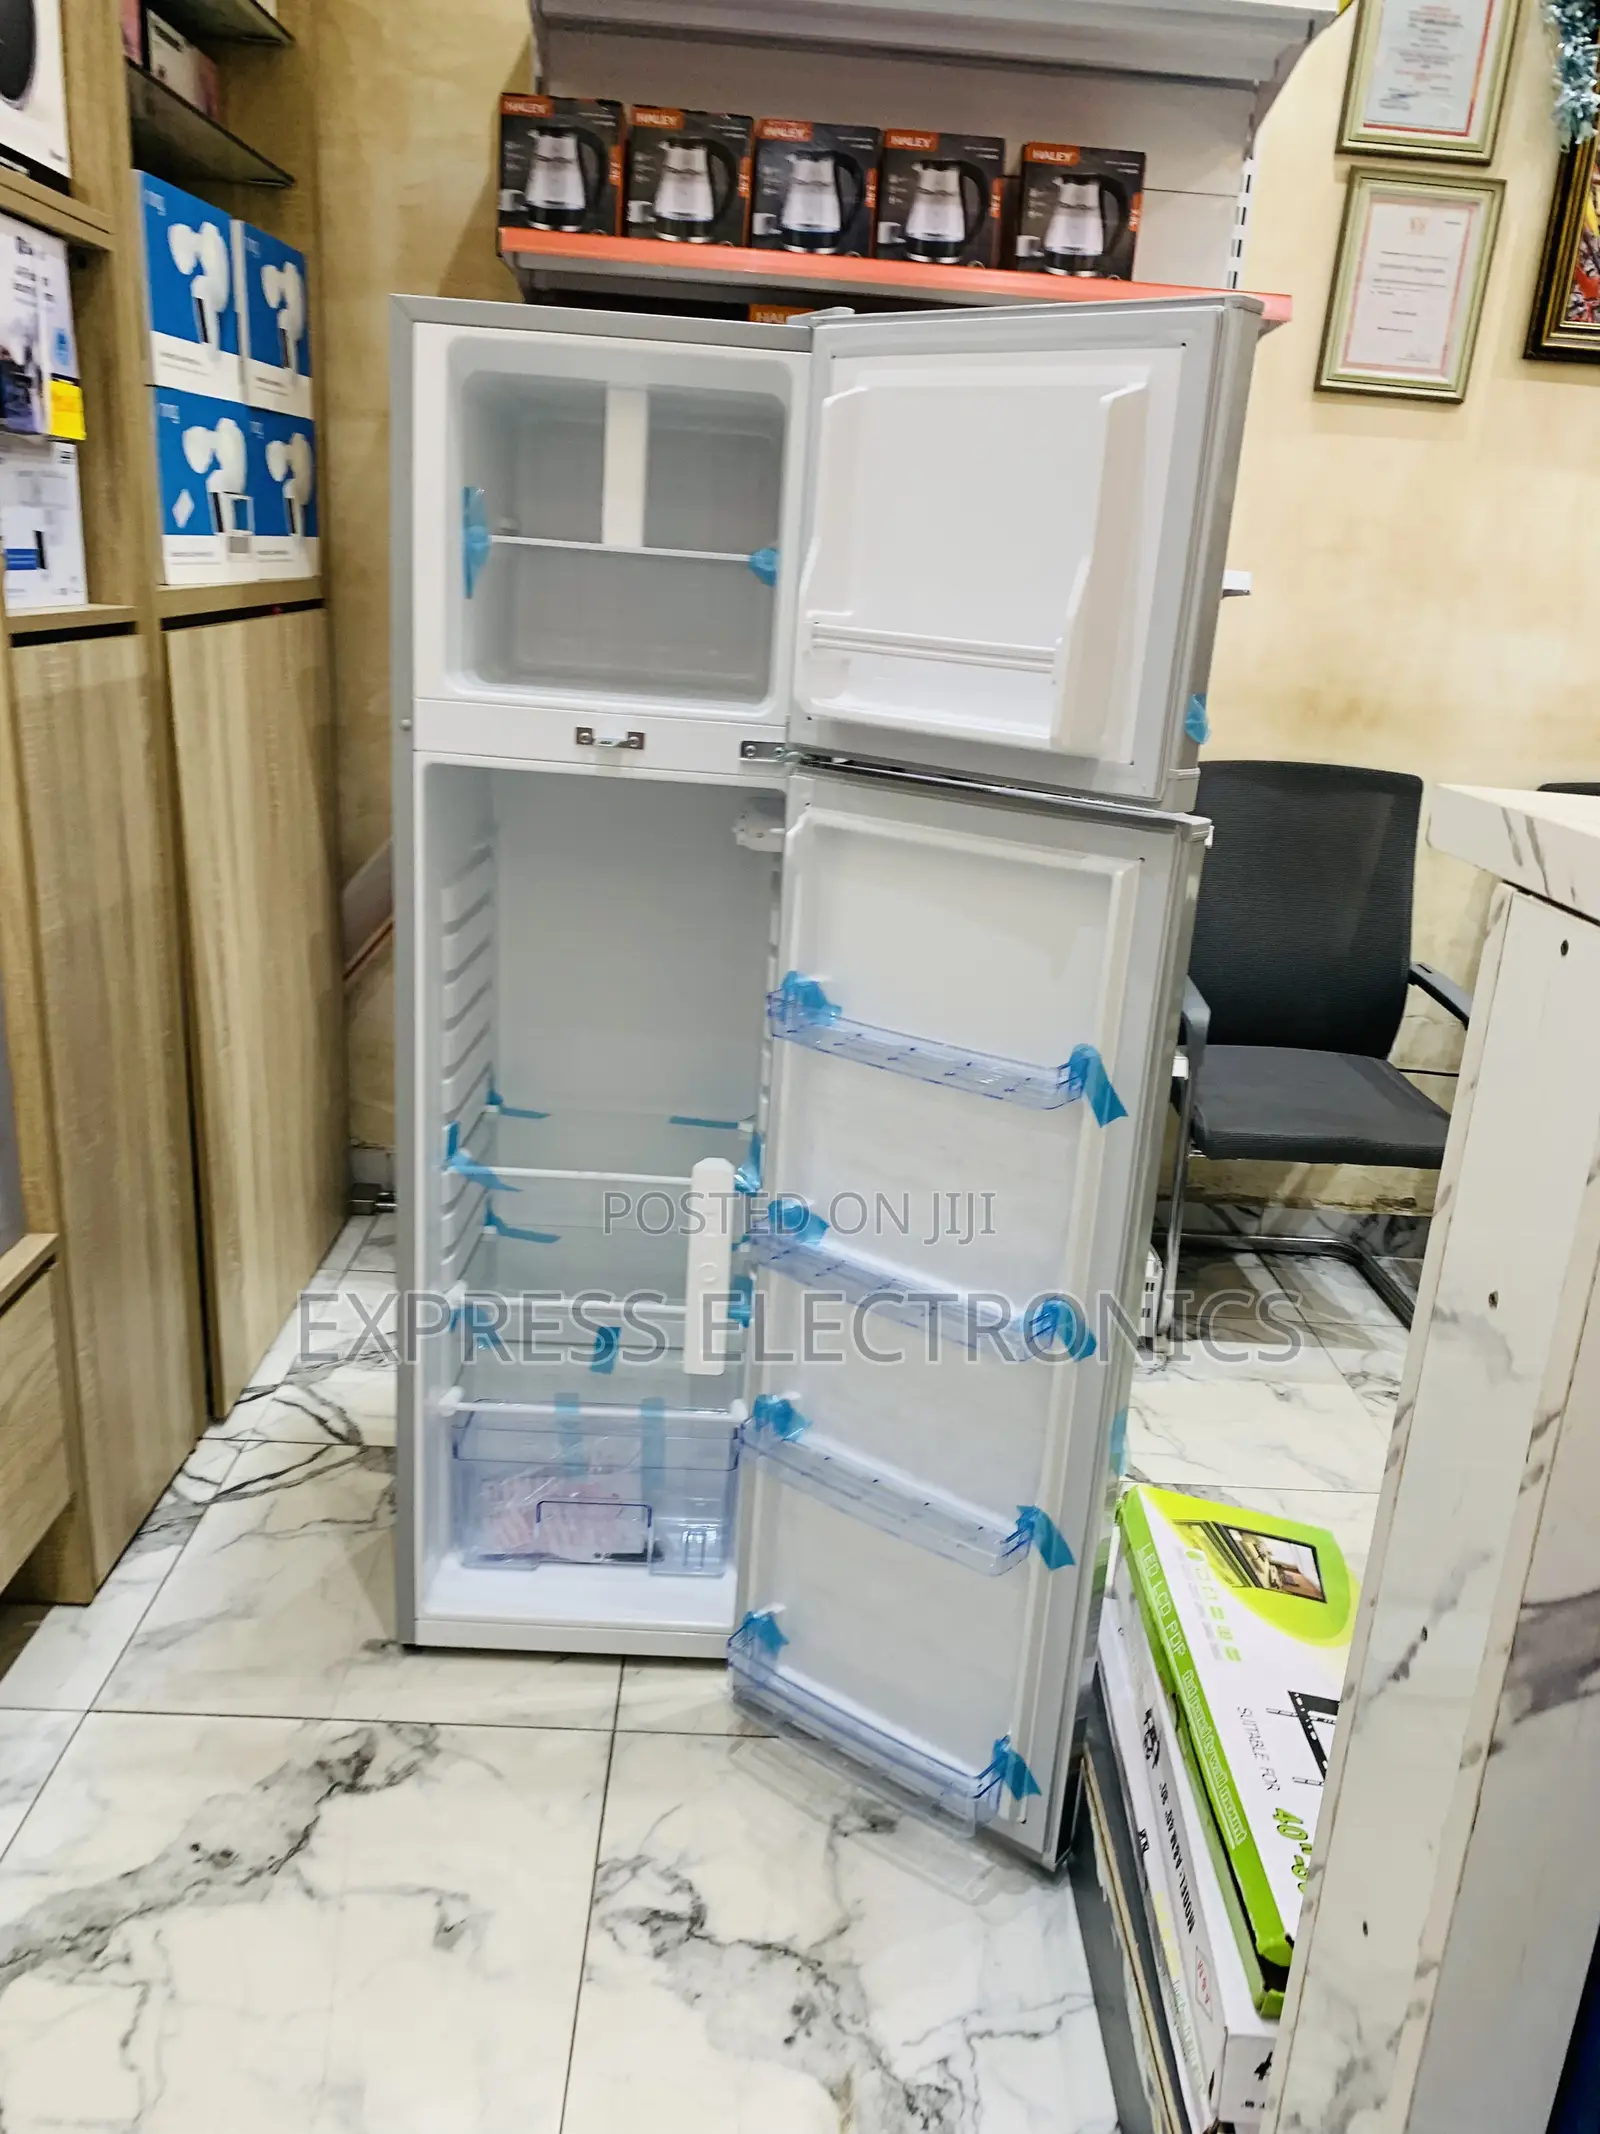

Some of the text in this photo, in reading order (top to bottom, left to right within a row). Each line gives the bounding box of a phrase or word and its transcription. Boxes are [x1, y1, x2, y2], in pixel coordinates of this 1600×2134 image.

[1139, 1541, 1161, 1578] LED
[1152, 1580, 1172, 1618] LCD
[1165, 1621, 1188, 1657] PDP
[1237, 1705, 1282, 1792] SUITABLE FOR
